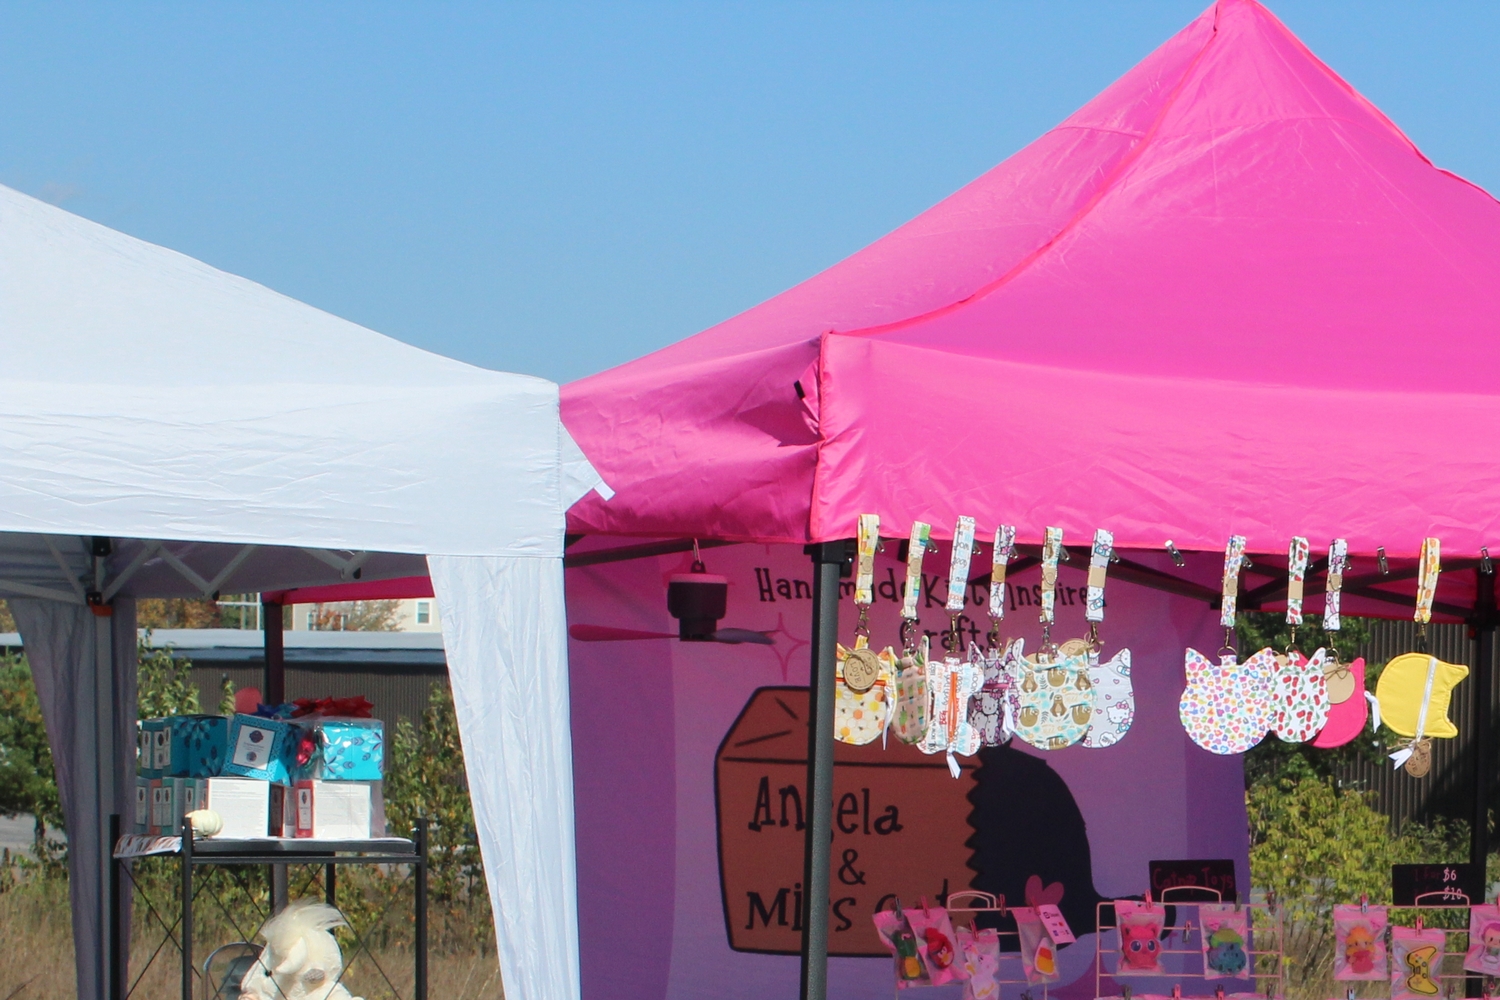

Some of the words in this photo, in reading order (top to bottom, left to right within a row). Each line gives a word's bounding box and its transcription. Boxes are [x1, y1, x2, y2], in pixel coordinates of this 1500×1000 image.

[754, 567, 907, 603] Hanmd
[748, 776, 903, 843] Anela
[837, 849, 866, 885] &
[1442, 867, 1457, 882] $6
[745, 883, 856, 932] Mis
